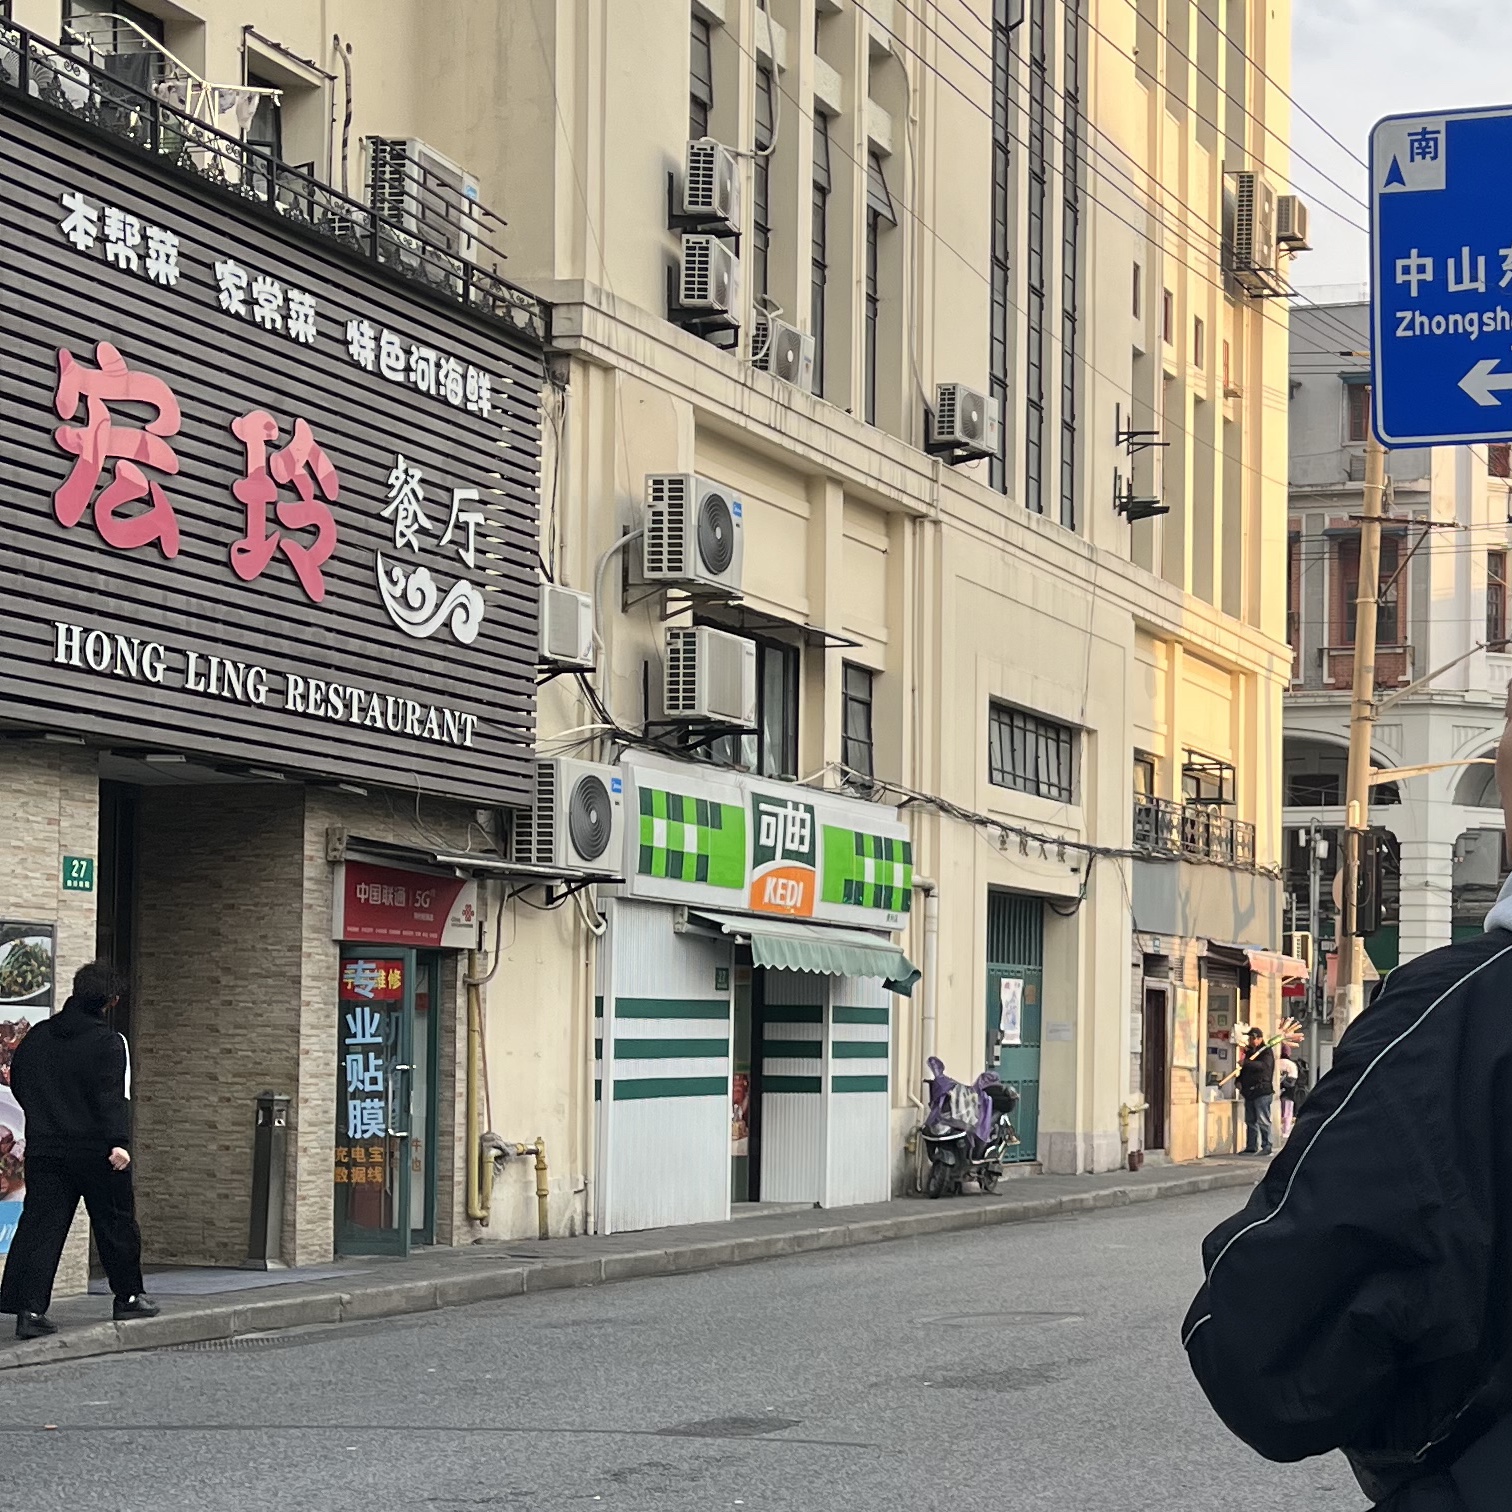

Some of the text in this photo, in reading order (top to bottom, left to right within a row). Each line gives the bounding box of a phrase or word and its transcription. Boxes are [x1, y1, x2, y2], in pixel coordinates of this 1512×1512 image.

[1407, 126, 1441, 163] 南
[59, 192, 492, 418] 本帮菜 家常菜 特色河海鲜
[54, 341, 487, 602] 宏玲 餐厅
[53, 621, 478, 748] HONG LING RESTAURANT
[71, 859, 87, 878] 27
[356, 882, 406, 907] 中国联通
[763, 876, 804, 907] KEDI
[343, 960, 386, 1140] 专业贴膜
